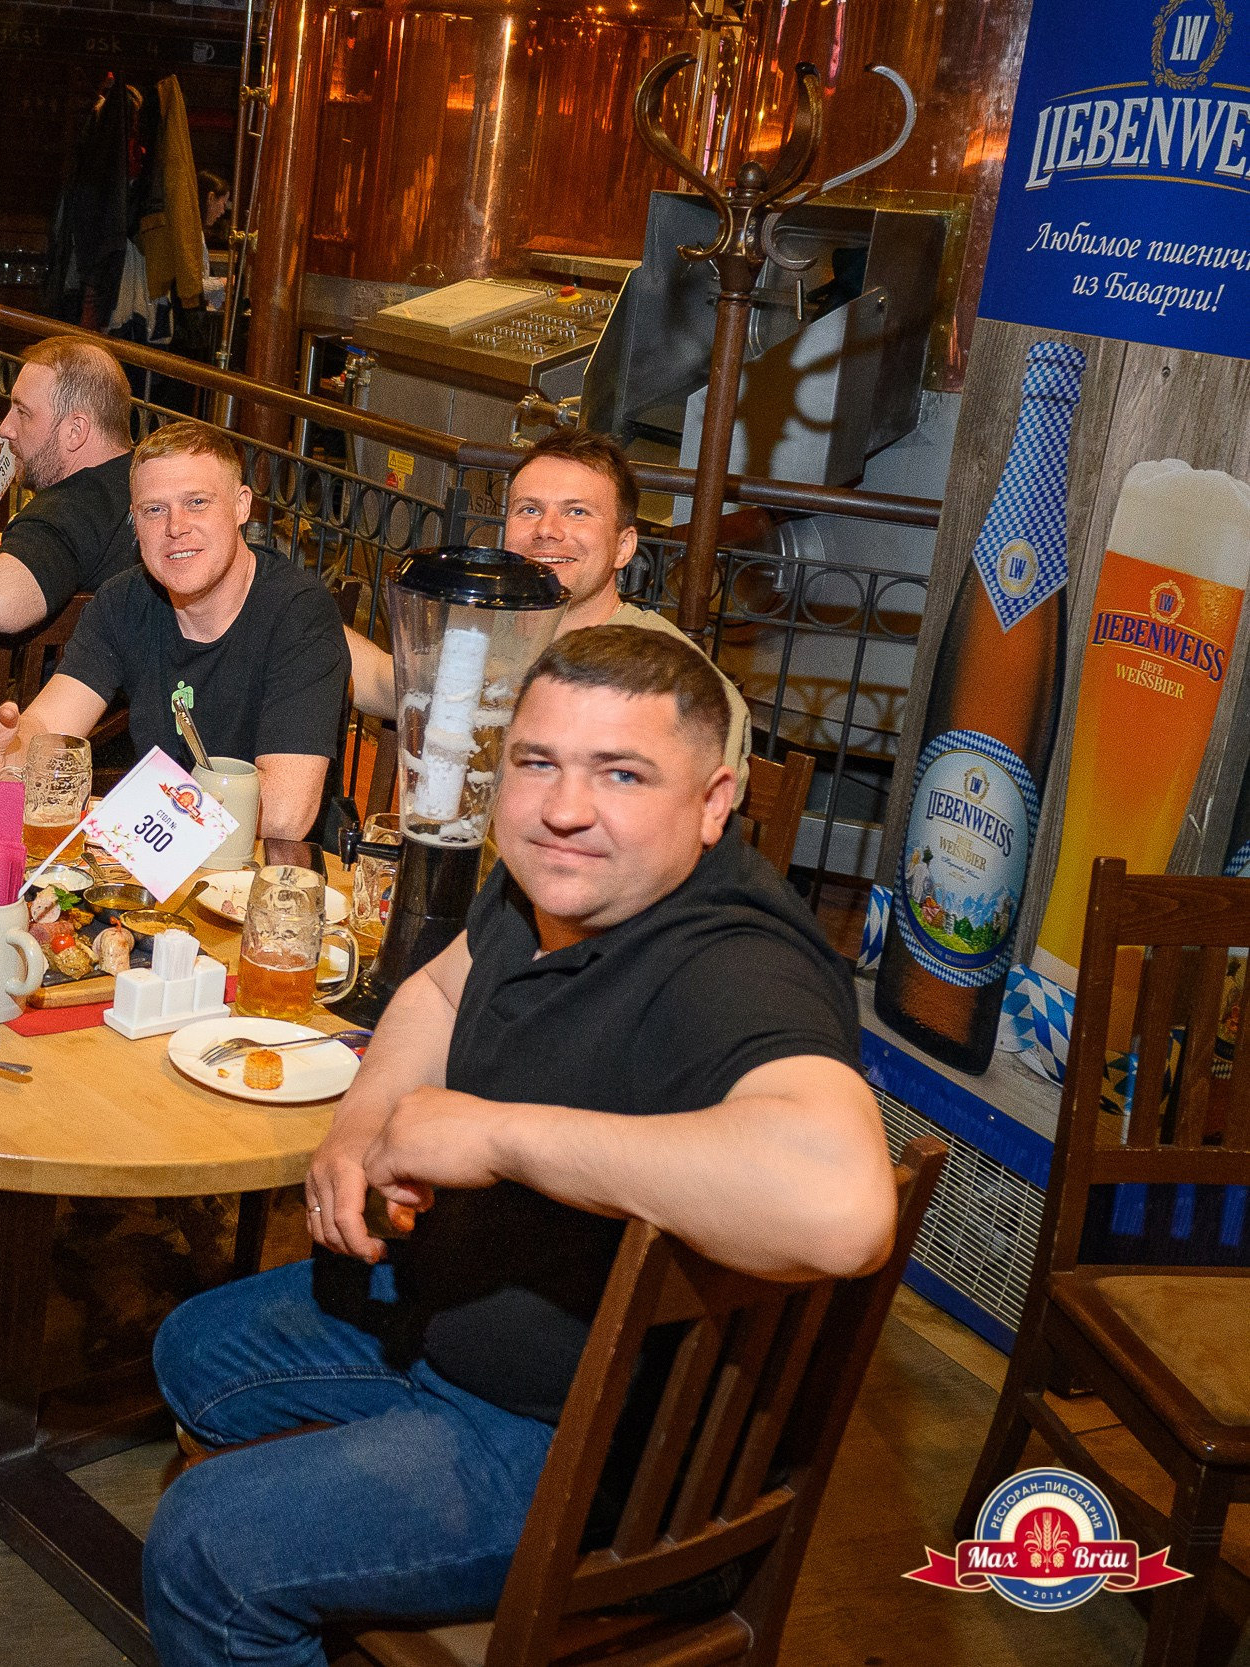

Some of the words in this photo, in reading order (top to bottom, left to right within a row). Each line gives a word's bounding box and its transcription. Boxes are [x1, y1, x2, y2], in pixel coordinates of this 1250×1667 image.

[1169, 15, 1211, 61] LW
[1025, 97, 1250, 191] LIEBENWE
[1026, 221, 1142, 259] Любимое
[1072, 274, 1099, 296] из
[1104, 271, 1225, 316] Баварии!
[0, 456, 11, 477] 310
[1009, 556, 1027, 580] LW
[1158, 593, 1175, 613] LW
[1091, 612, 1225, 683] LIEBENWEISS
[1115, 663, 1186, 700] WEISSBIER
[1139, 659, 1165, 677] HEFE
[969, 776, 983, 795] LW
[134, 814, 173, 853] 300
[926, 789, 1014, 857] LIEBENWEISS
